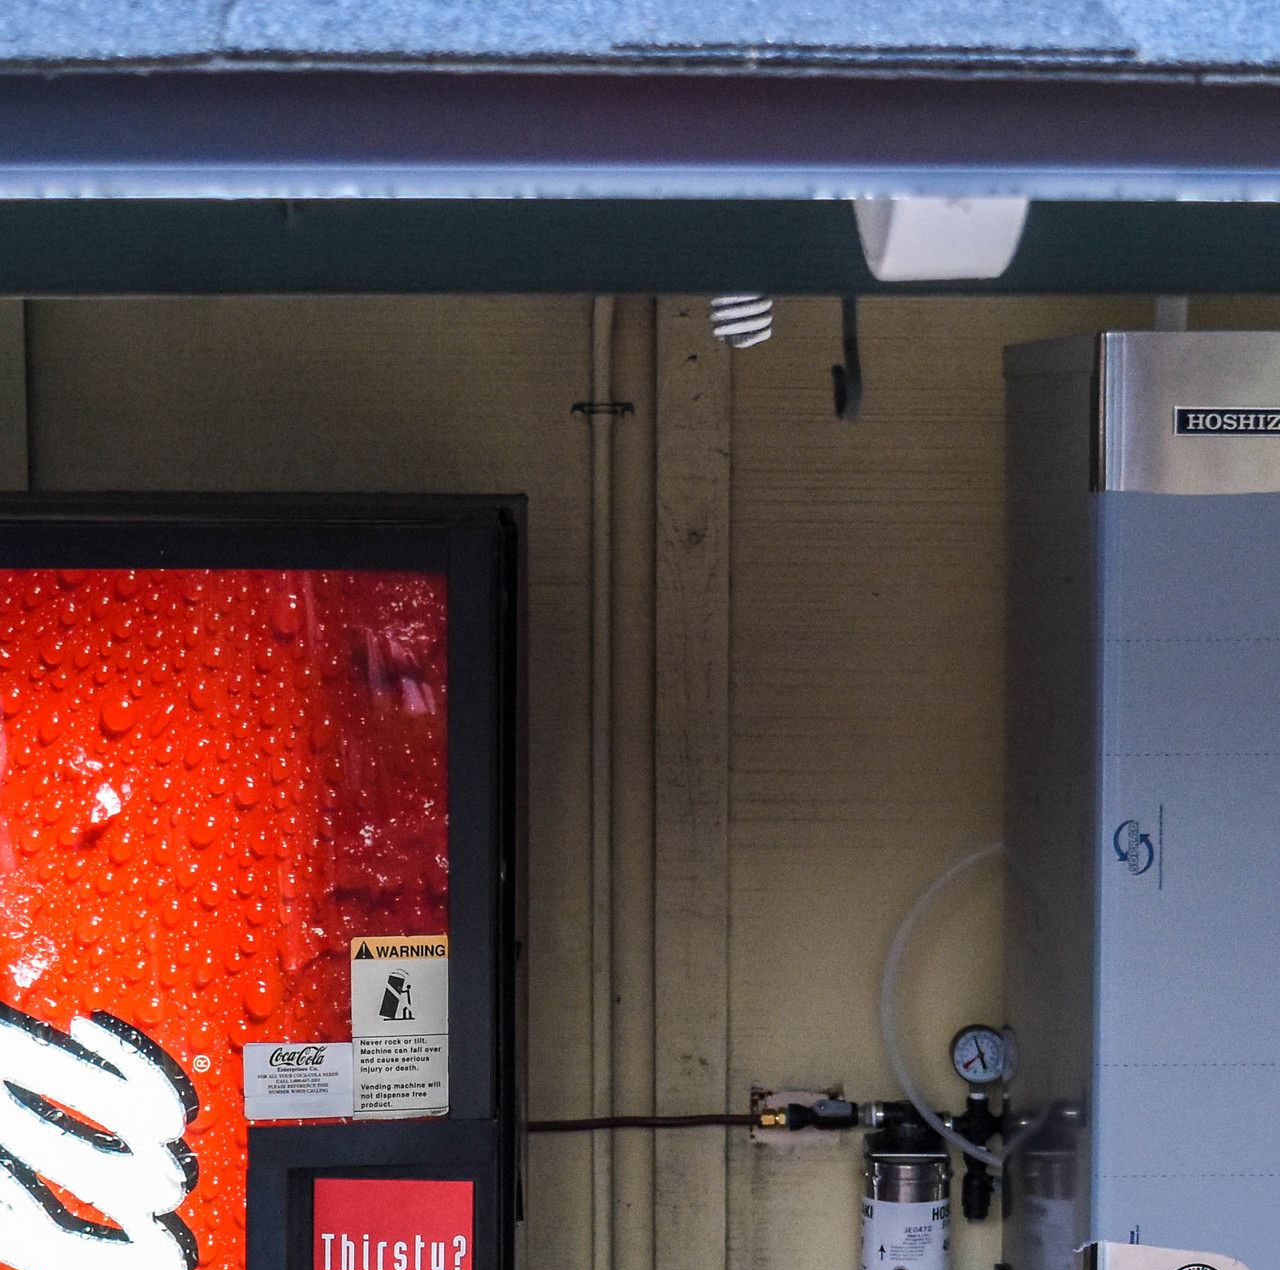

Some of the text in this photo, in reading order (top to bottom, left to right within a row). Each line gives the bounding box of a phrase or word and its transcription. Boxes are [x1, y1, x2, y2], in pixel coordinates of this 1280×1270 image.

[376, 945, 446, 958] WARNING
[269, 1046, 327, 1066] Coca-Cola
[361, 1101, 393, 1109] product.
